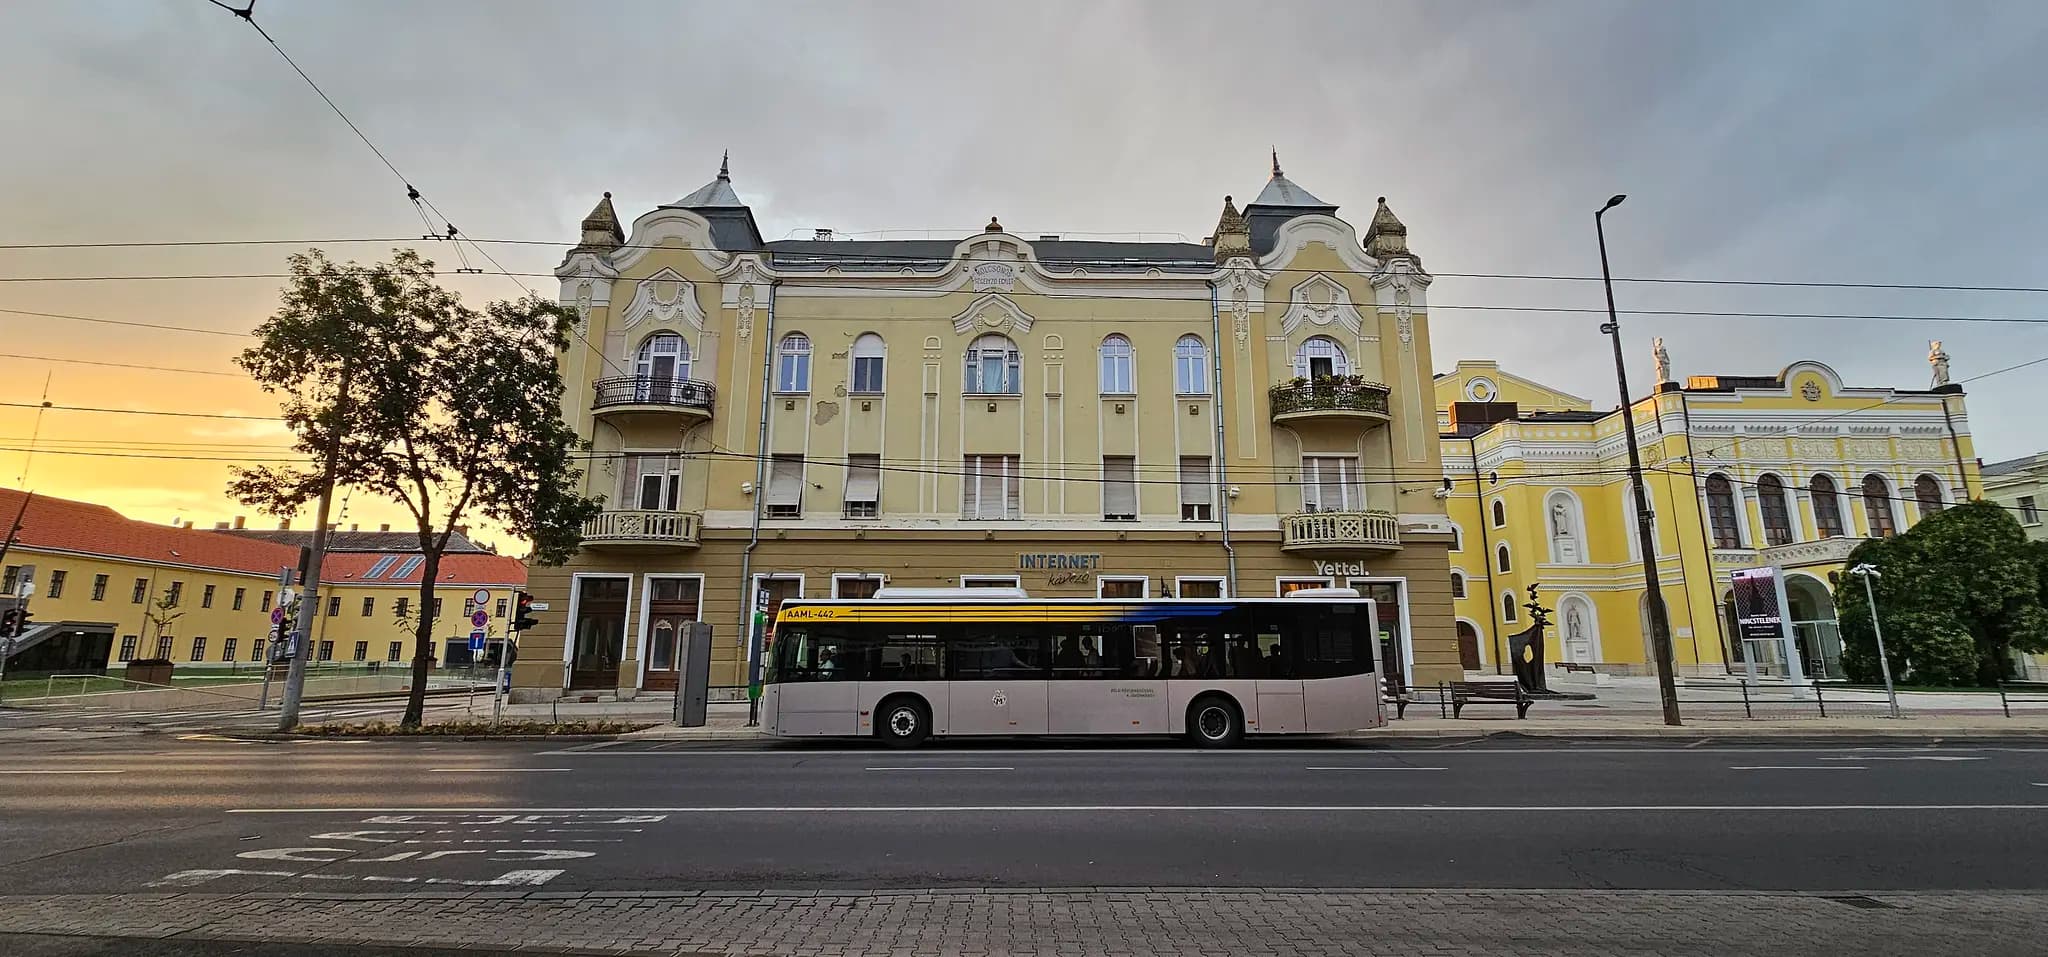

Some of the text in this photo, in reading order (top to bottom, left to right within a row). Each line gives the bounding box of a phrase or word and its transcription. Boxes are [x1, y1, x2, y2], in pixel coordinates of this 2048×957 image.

[1020, 554, 1100, 569] INTERNET
[1313, 560, 1370, 576] Yettel.
[787, 610, 834, 618] AAML-442
